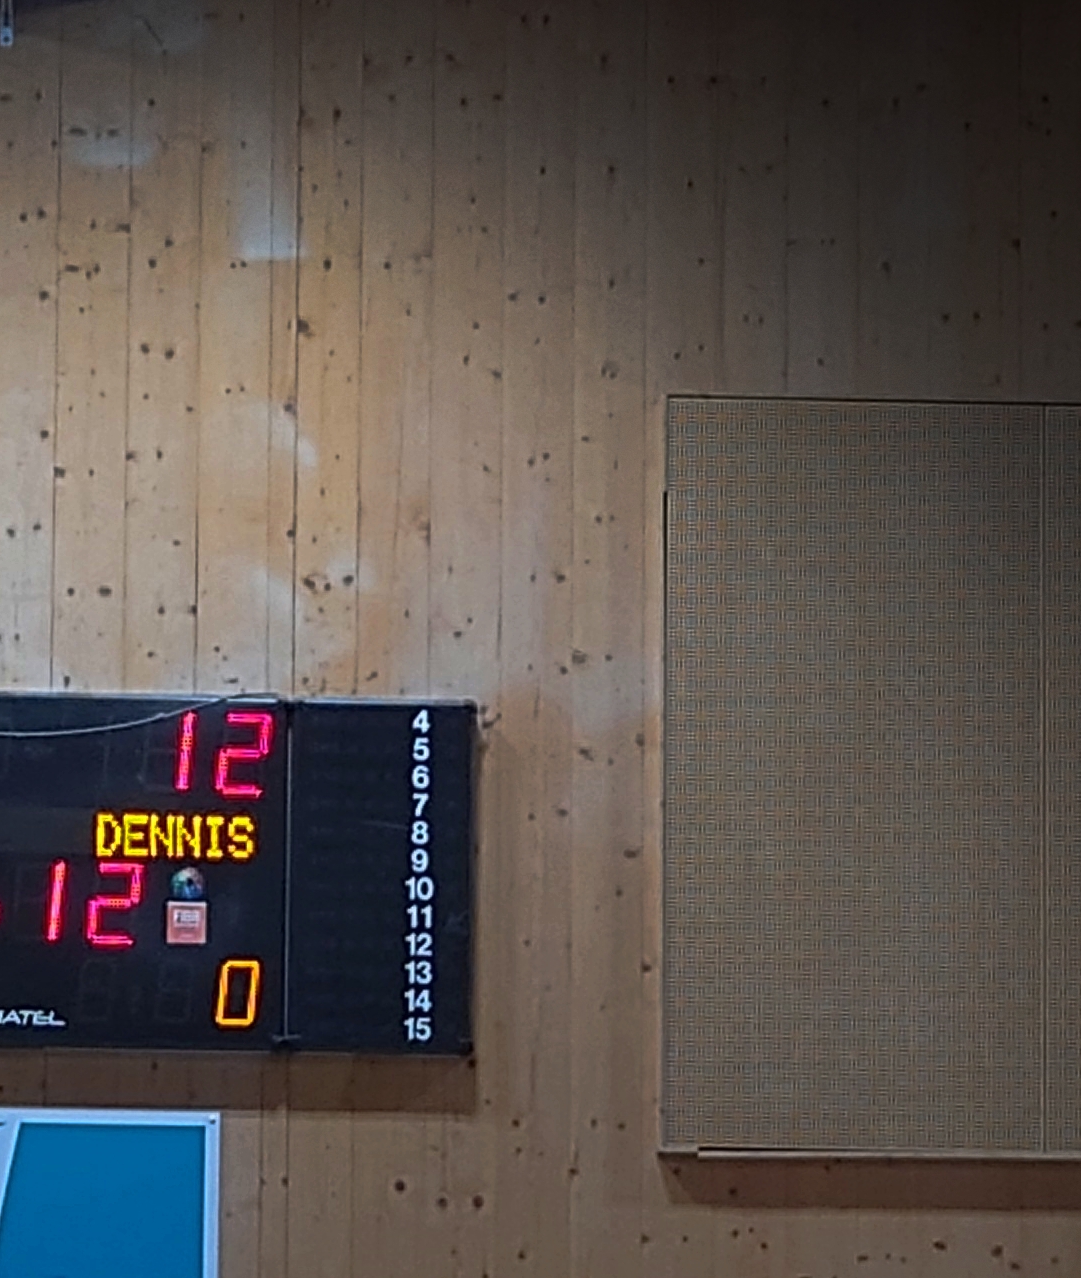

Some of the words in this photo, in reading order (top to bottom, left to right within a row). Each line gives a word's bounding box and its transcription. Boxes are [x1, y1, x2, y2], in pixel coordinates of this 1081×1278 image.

[412, 709, 431, 734] 4
[174, 711, 273, 798] 12
[412, 736, 430, 762] 5
[411, 764, 430, 790] 6
[412, 792, 430, 818] 7
[96, 814, 256, 859] DENNIS
[410, 820, 430, 845] 8
[410, 848, 429, 873] 9
[404, 876, 435, 901] 10
[406, 904, 433, 929] 11
[405, 932, 433, 957] 12
[404, 960, 433, 985] 13
[215, 960, 261, 1028] 0
[404, 988, 433, 1013] 14
[403, 1016, 432, 1042] 15
